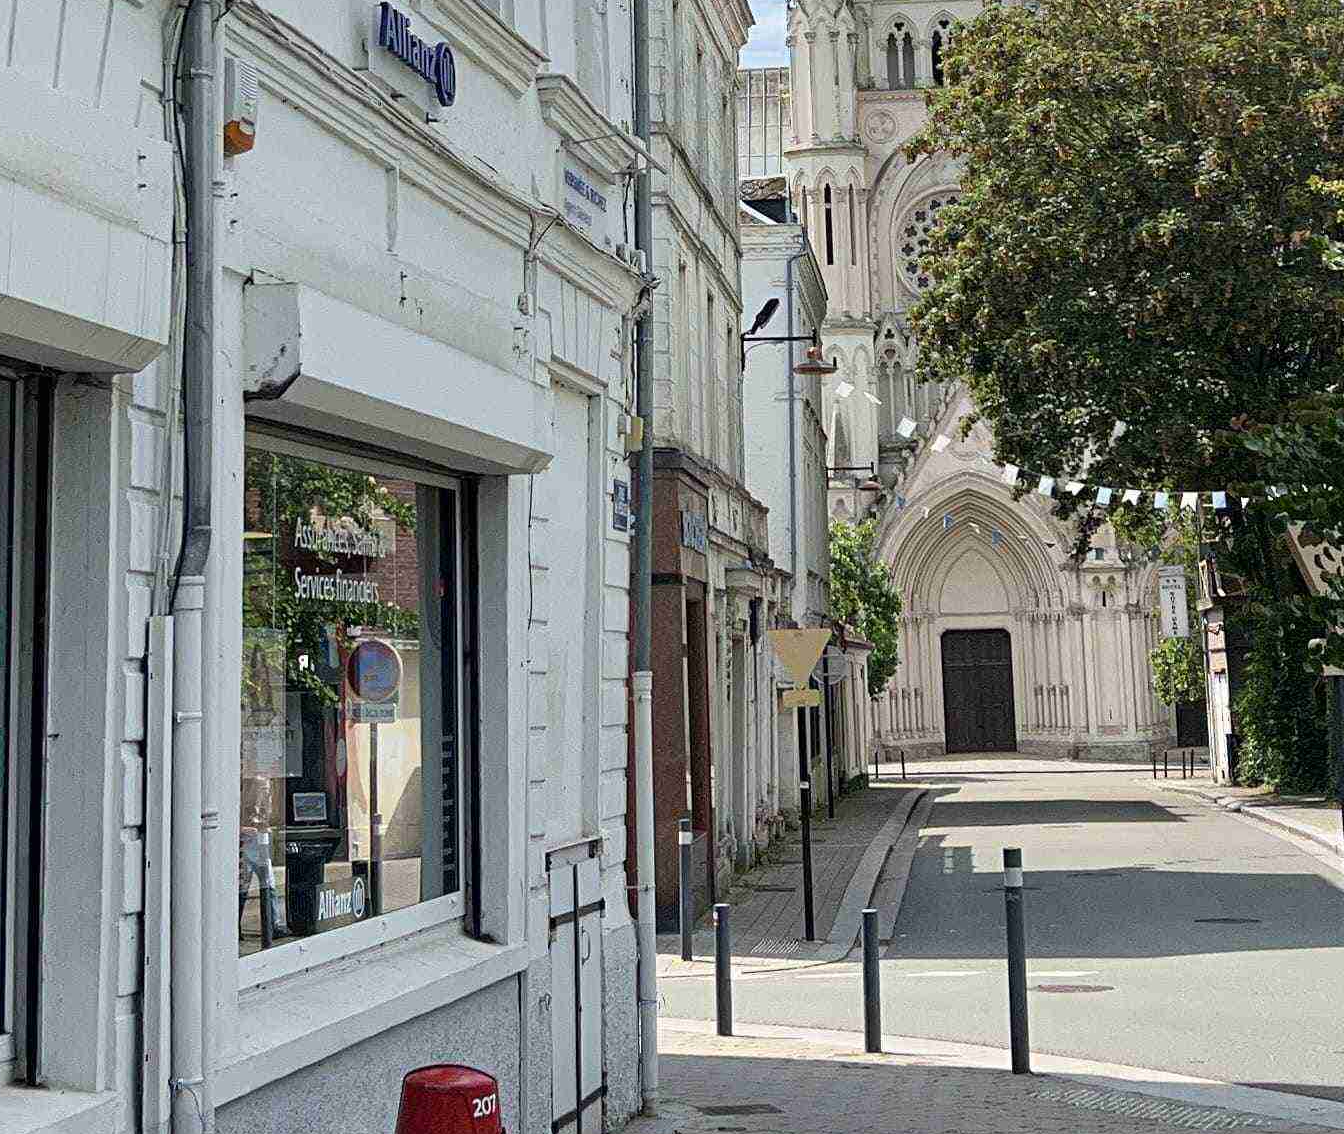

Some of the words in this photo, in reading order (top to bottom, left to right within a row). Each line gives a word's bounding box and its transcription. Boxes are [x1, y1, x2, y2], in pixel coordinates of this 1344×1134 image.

[379, 2, 435, 84] Allianz
[294, 567, 336, 601] Services
[336, 568, 379, 603] financiers
[318, 889, 352, 921] Allianz
[472, 1094, 496, 1117] 207
